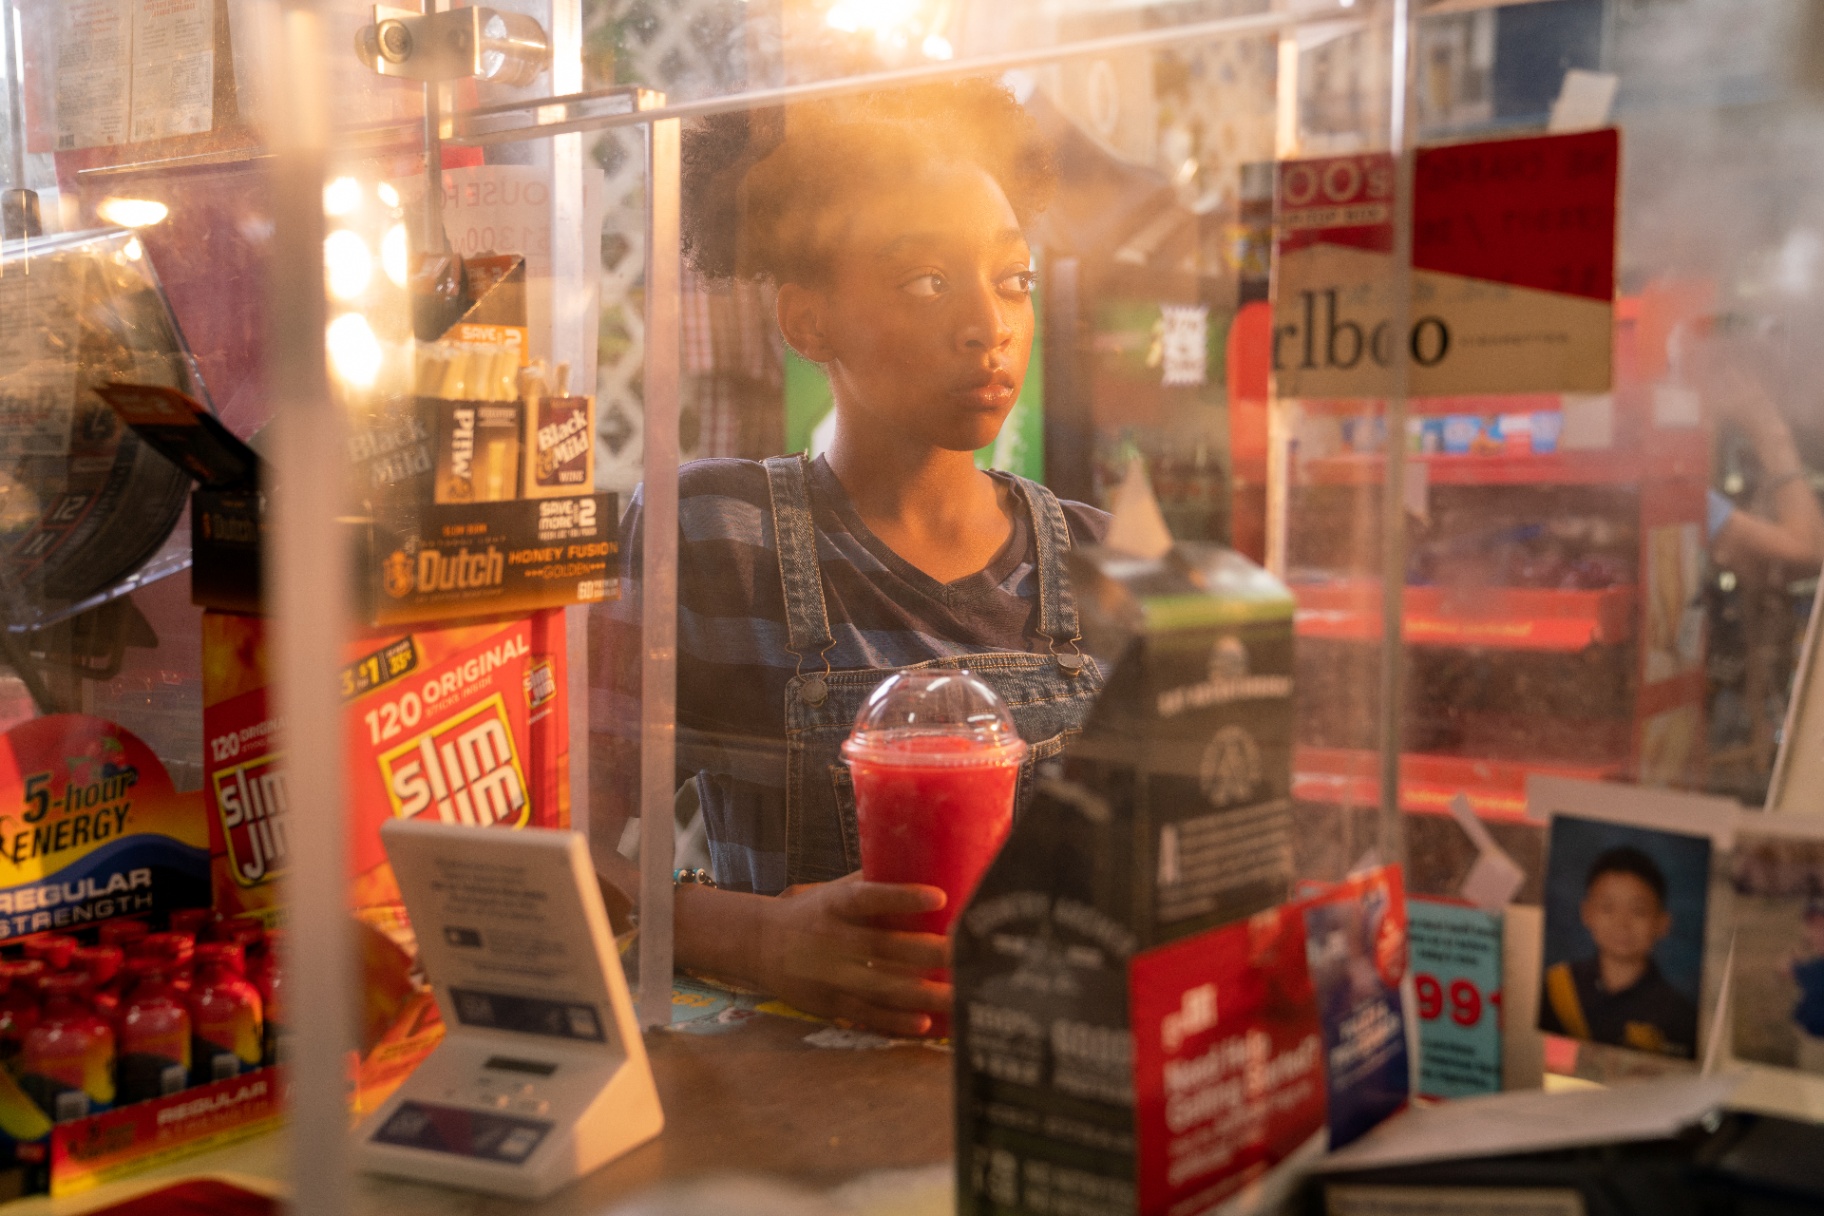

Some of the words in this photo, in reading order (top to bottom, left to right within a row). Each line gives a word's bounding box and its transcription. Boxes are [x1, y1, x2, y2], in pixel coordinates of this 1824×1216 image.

[452, 409, 475, 479] Mild
[538, 409, 589, 452] Black
[553, 429, 590, 471] Mild
[558, 470, 586, 483] WINE
[539, 500, 574, 517] SAVE
[579, 498, 597, 527] 2
[418, 545, 504, 593] Dutch
[508, 547, 564, 566] HONEY
[567, 541, 619, 559] FUSION
[364, 691, 423, 746] 120
[422, 633, 530, 705] ORIGINAL
[211, 732, 240, 763] 120
[23, 766, 134, 824] 5-hour
[13, 802, 130, 865] ENERGY
